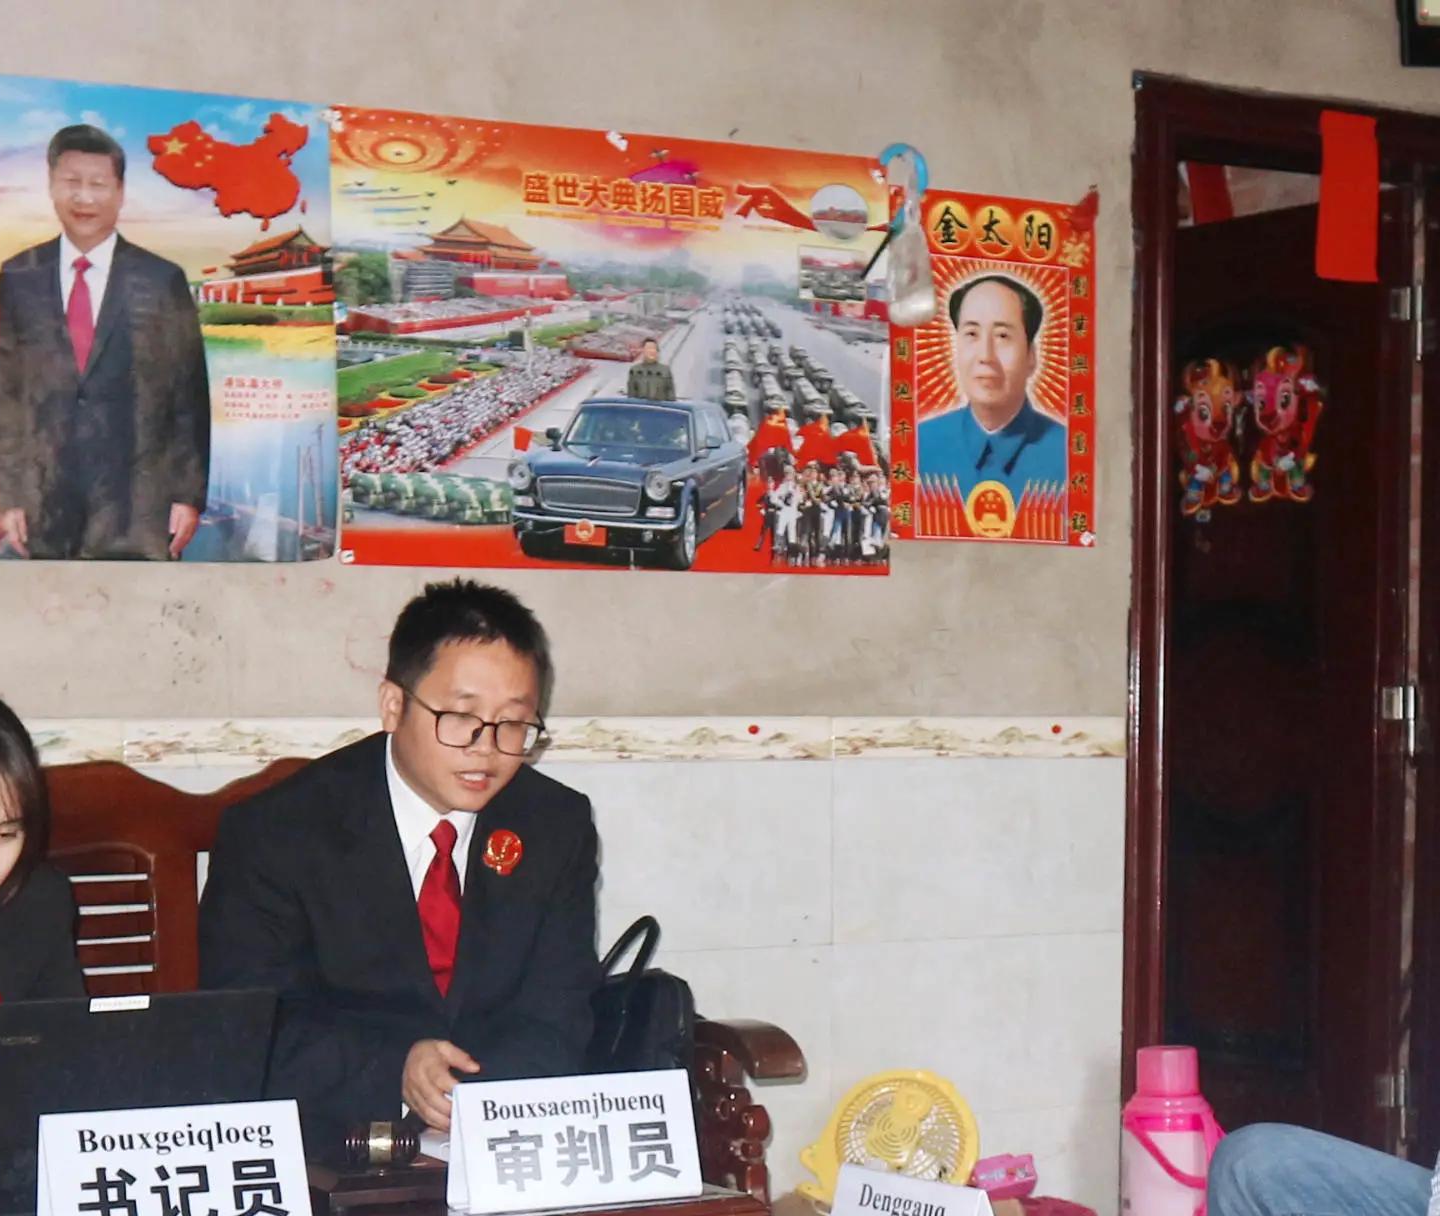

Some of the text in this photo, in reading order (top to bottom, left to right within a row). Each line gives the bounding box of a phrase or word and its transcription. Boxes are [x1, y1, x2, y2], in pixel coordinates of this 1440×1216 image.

[523, 172, 725, 219] 盛世大典扬国威
[933, 205, 1053, 251] 金太阳
[481, 1092, 667, 1121] Bouxsaemjbuenq
[77, 1121, 275, 1155] Bouxgeiqloeg
[486, 1120, 682, 1193] 审判员
